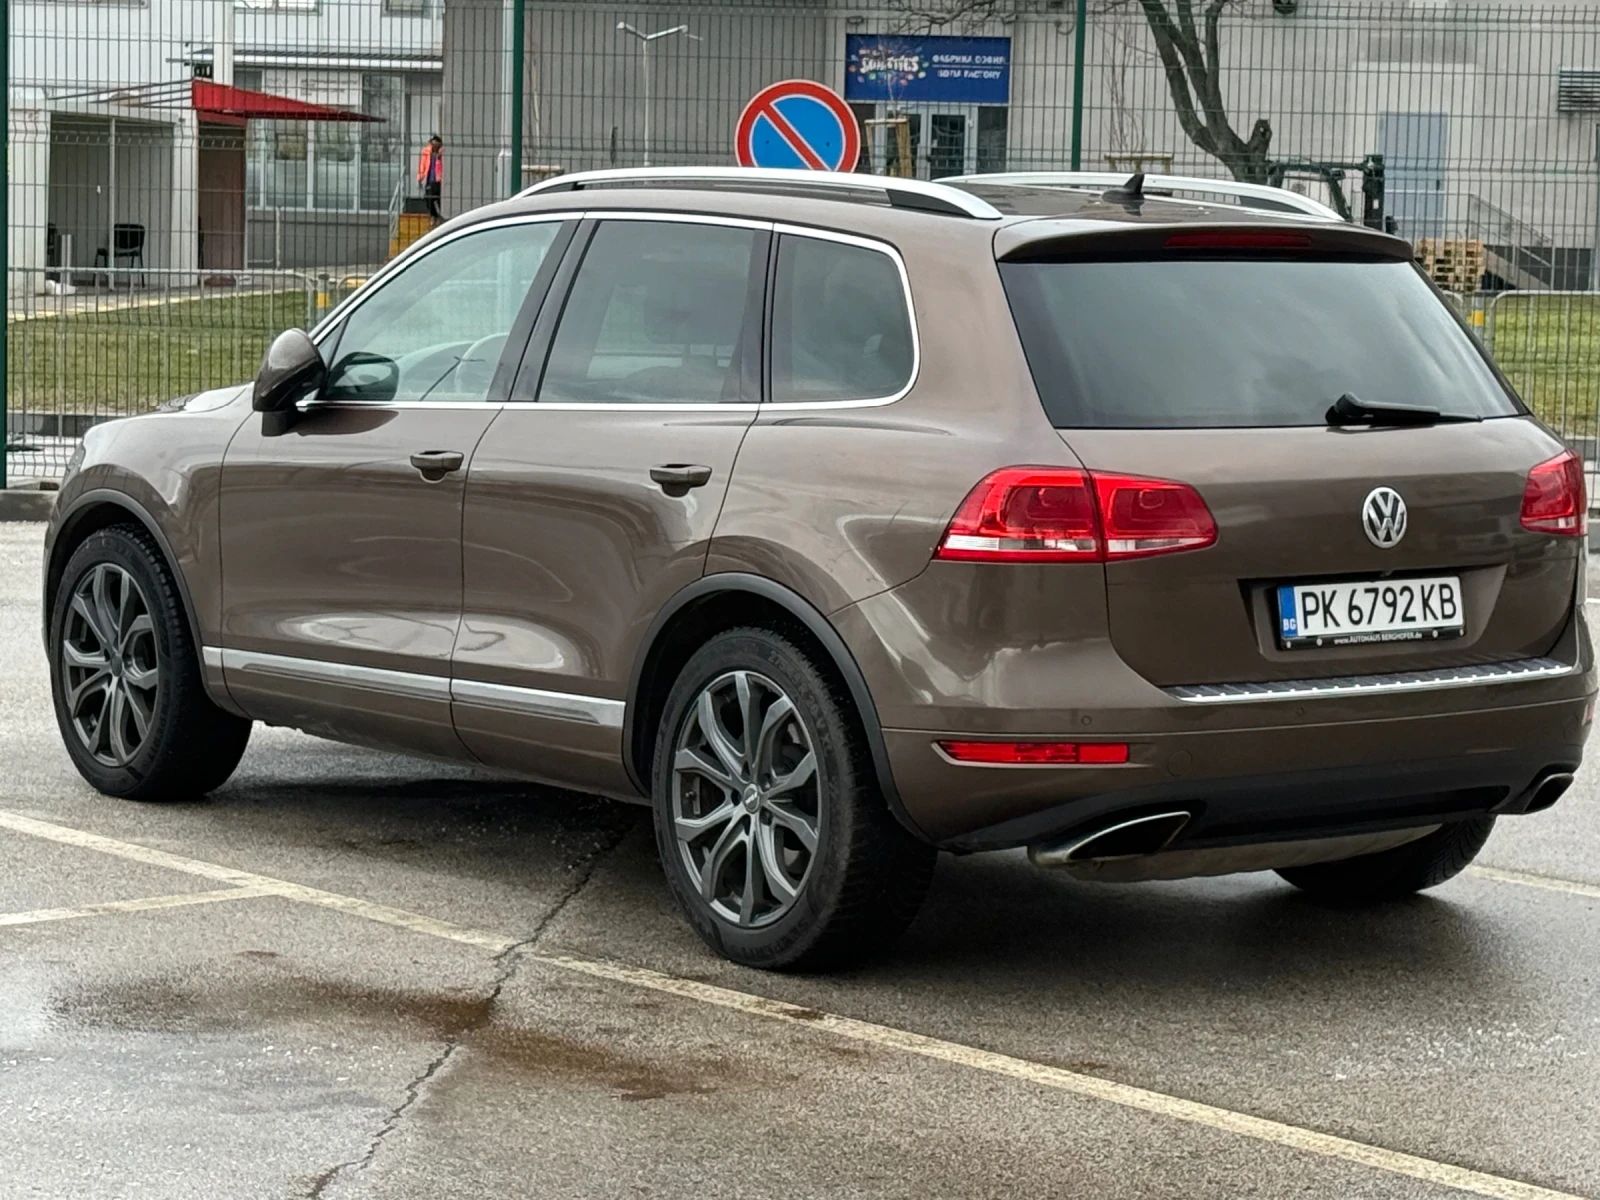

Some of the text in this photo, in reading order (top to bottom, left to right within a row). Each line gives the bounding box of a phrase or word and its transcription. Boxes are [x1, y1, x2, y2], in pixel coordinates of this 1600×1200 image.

[963, 69, 1002, 79] FACTORY
[1301, 583, 1457, 630] PK 6792 KB
[1282, 618, 1297, 632] BG
